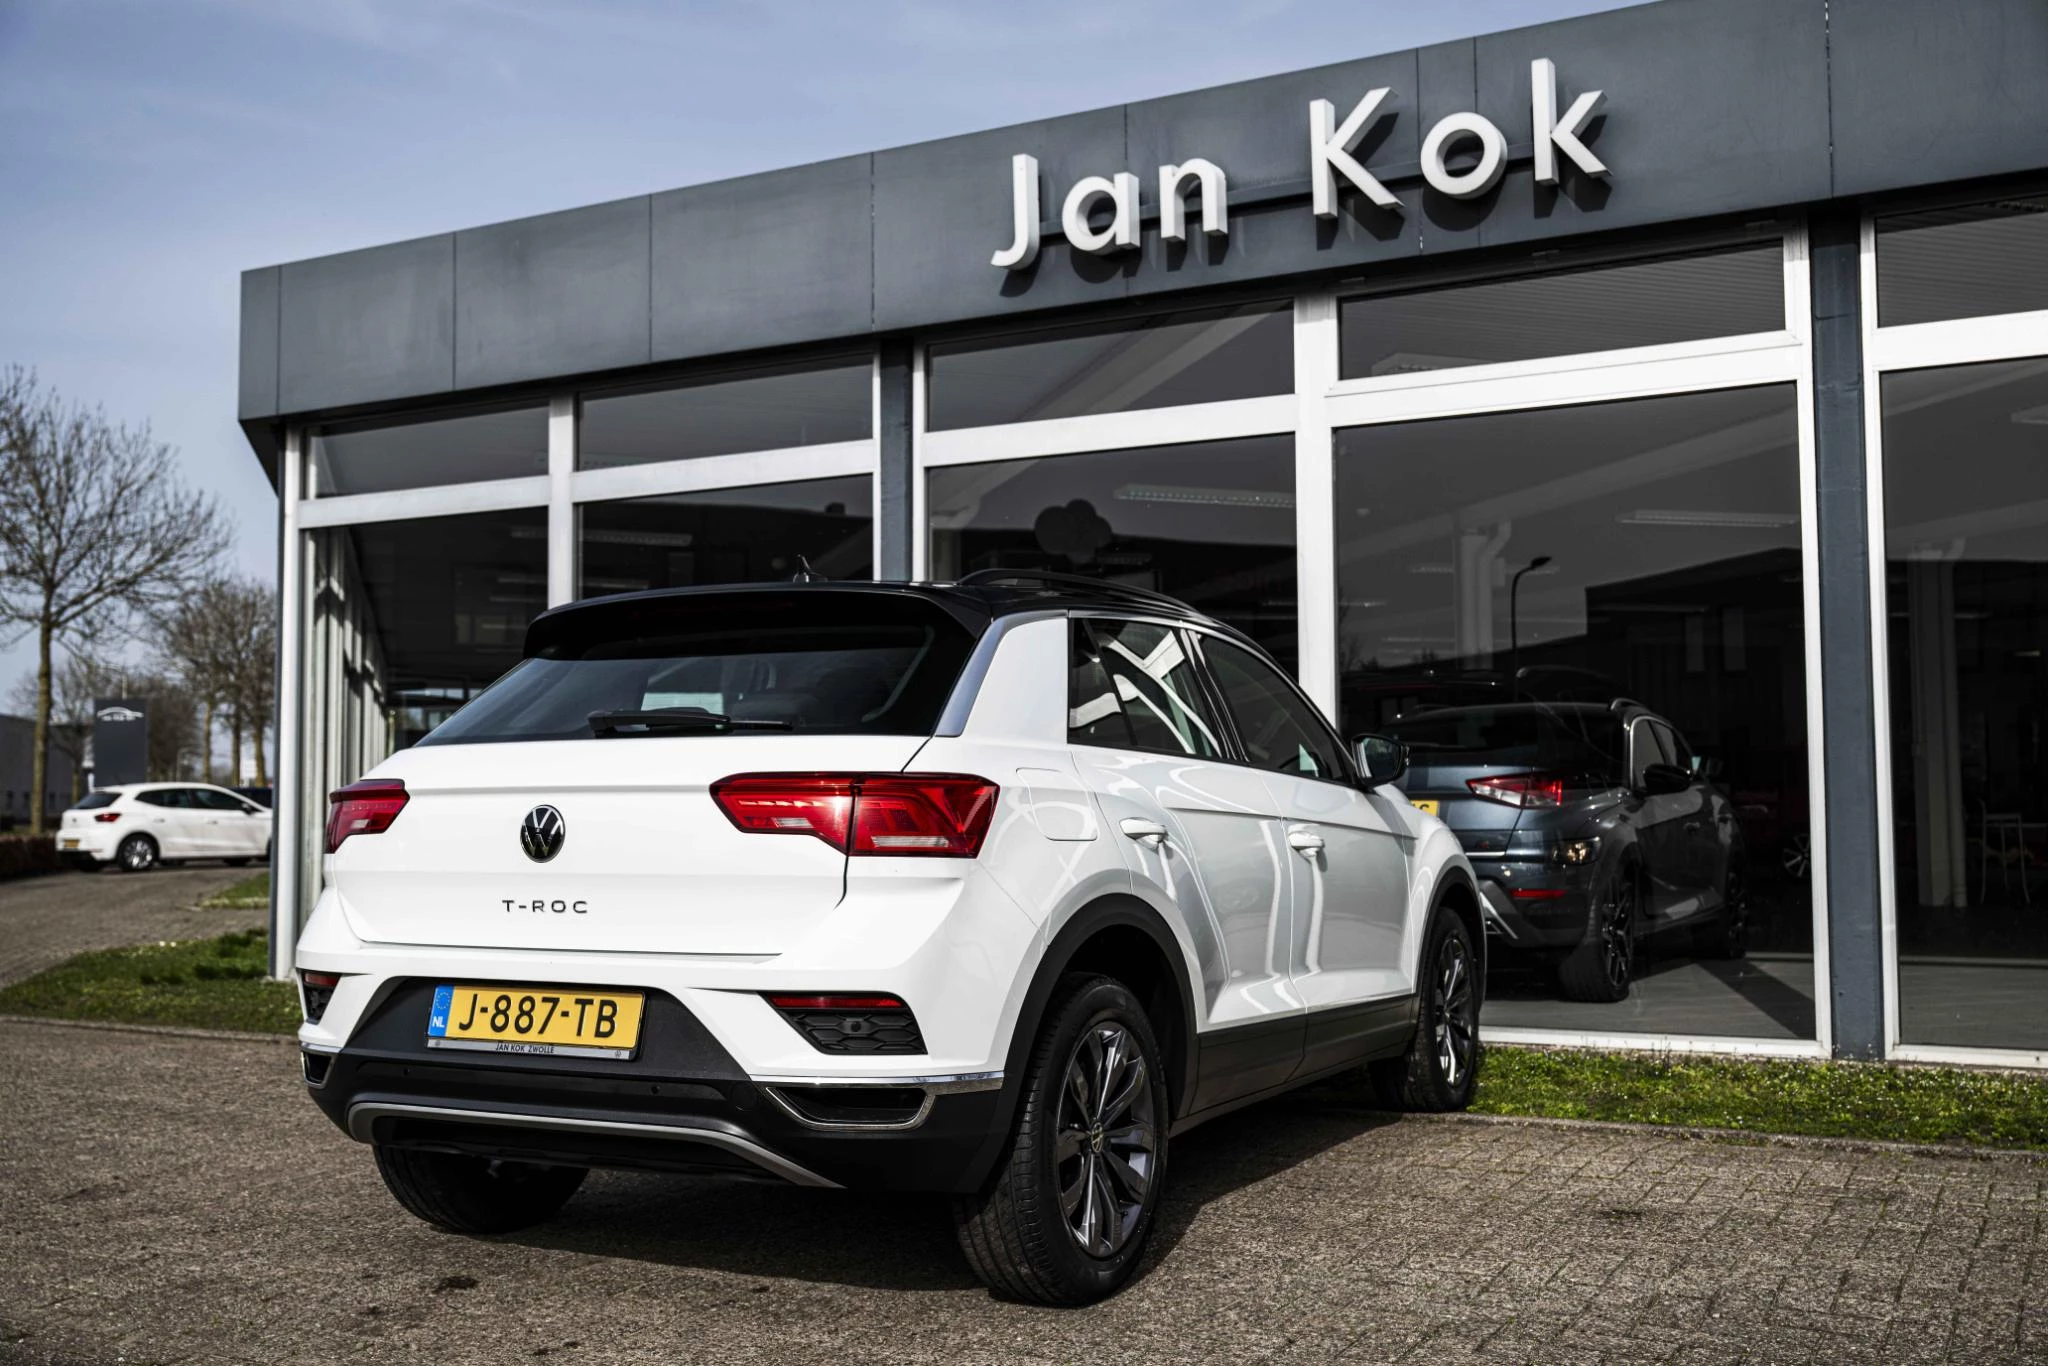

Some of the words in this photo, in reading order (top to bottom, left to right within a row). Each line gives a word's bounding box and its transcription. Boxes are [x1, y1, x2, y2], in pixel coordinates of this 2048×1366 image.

[990, 153, 1228, 270] Jan
[1309, 57, 1614, 220] Kok
[502, 899, 588, 914] T-ROC
[431, 1016, 446, 1029] NL
[458, 992, 619, 1039] J-887-TB
[496, 1042, 509, 1051] JAN
[510, 1043, 525, 1052] KOK
[528, 1045, 555, 1054] ZWOLLE
